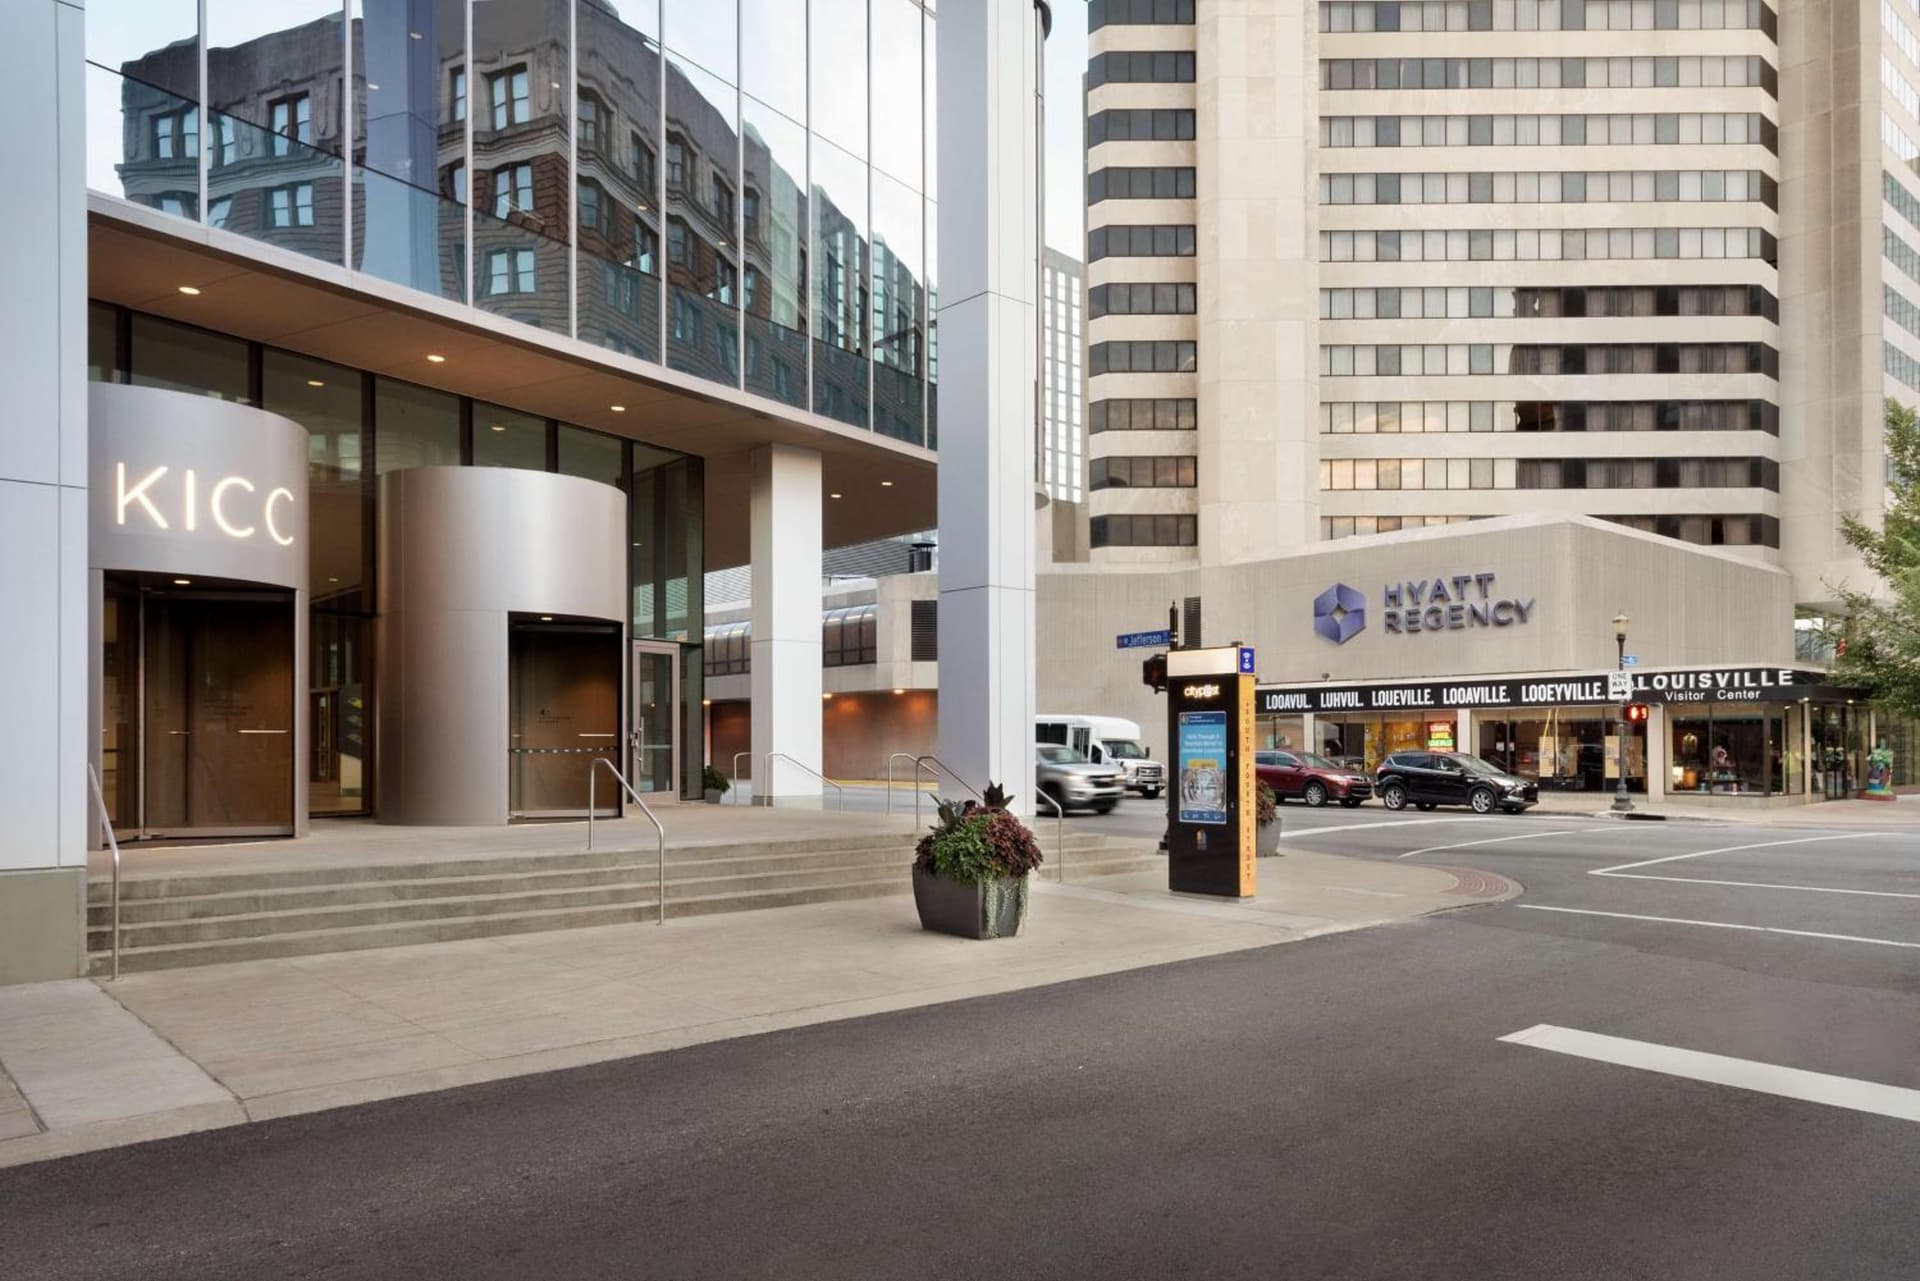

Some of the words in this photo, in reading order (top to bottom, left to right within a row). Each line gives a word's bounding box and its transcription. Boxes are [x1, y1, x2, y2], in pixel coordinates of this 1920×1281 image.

[117, 462, 294, 546] KICC
[1384, 573, 1495, 608] HYATT
[1384, 598, 1536, 635] REGENCY
[1612, 672, 1628, 680] ONE
[1612, 680, 1628, 688] WAY
[1638, 669, 1793, 691] LOUISVILLE
[1266, 693, 1312, 710] LOOAVUL.
[1320, 691, 1364, 708] LUHVUL.
[1371, 687, 1434, 707] LOUEVILLE.
[1443, 685, 1511, 705] LOOAVILLE.
[1521, 681, 1606, 703] LOOEYVILLE.
[1664, 690, 1705, 702] Visitor
[1716, 688, 1761, 701] Center
